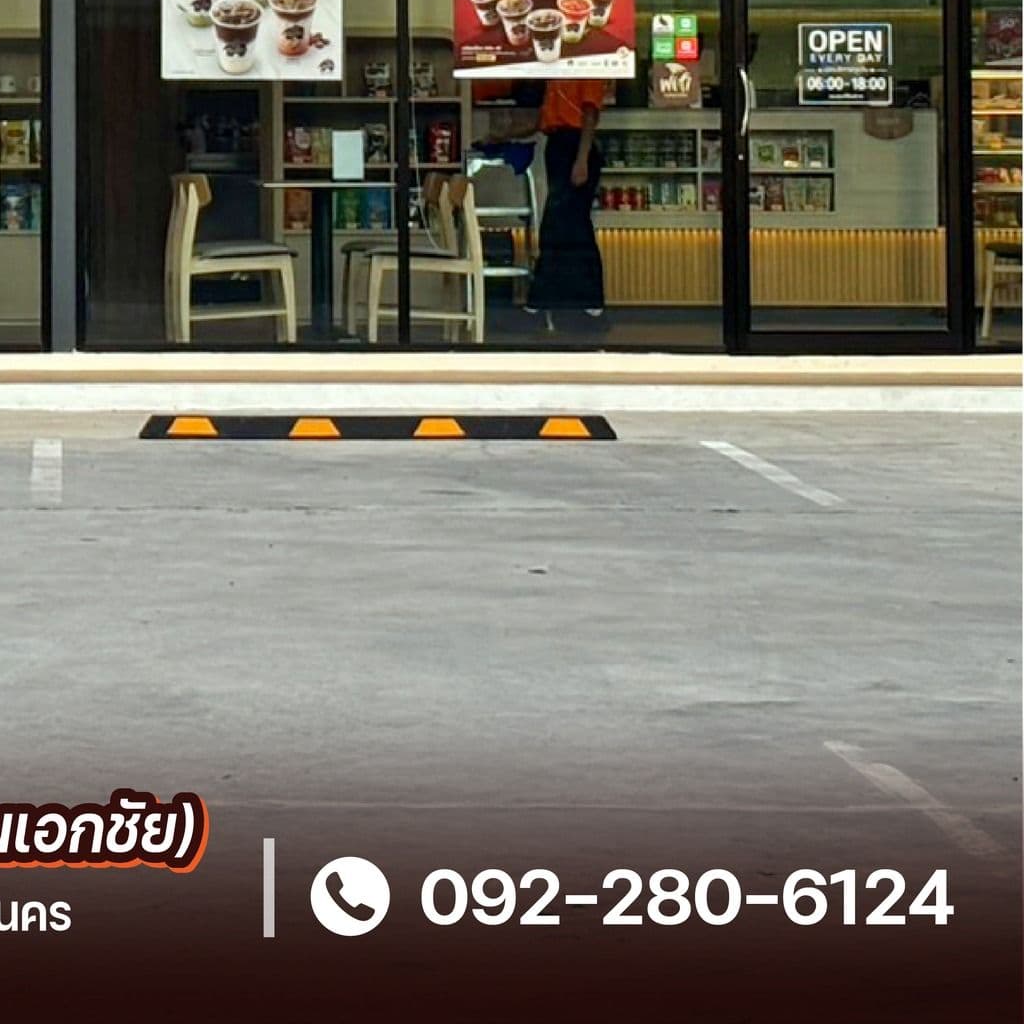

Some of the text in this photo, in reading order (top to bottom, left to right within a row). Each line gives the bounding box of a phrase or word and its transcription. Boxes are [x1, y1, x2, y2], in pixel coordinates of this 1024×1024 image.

[808, 30, 883, 53] OPEN
[809, 53, 883, 63] EVERY DAY
